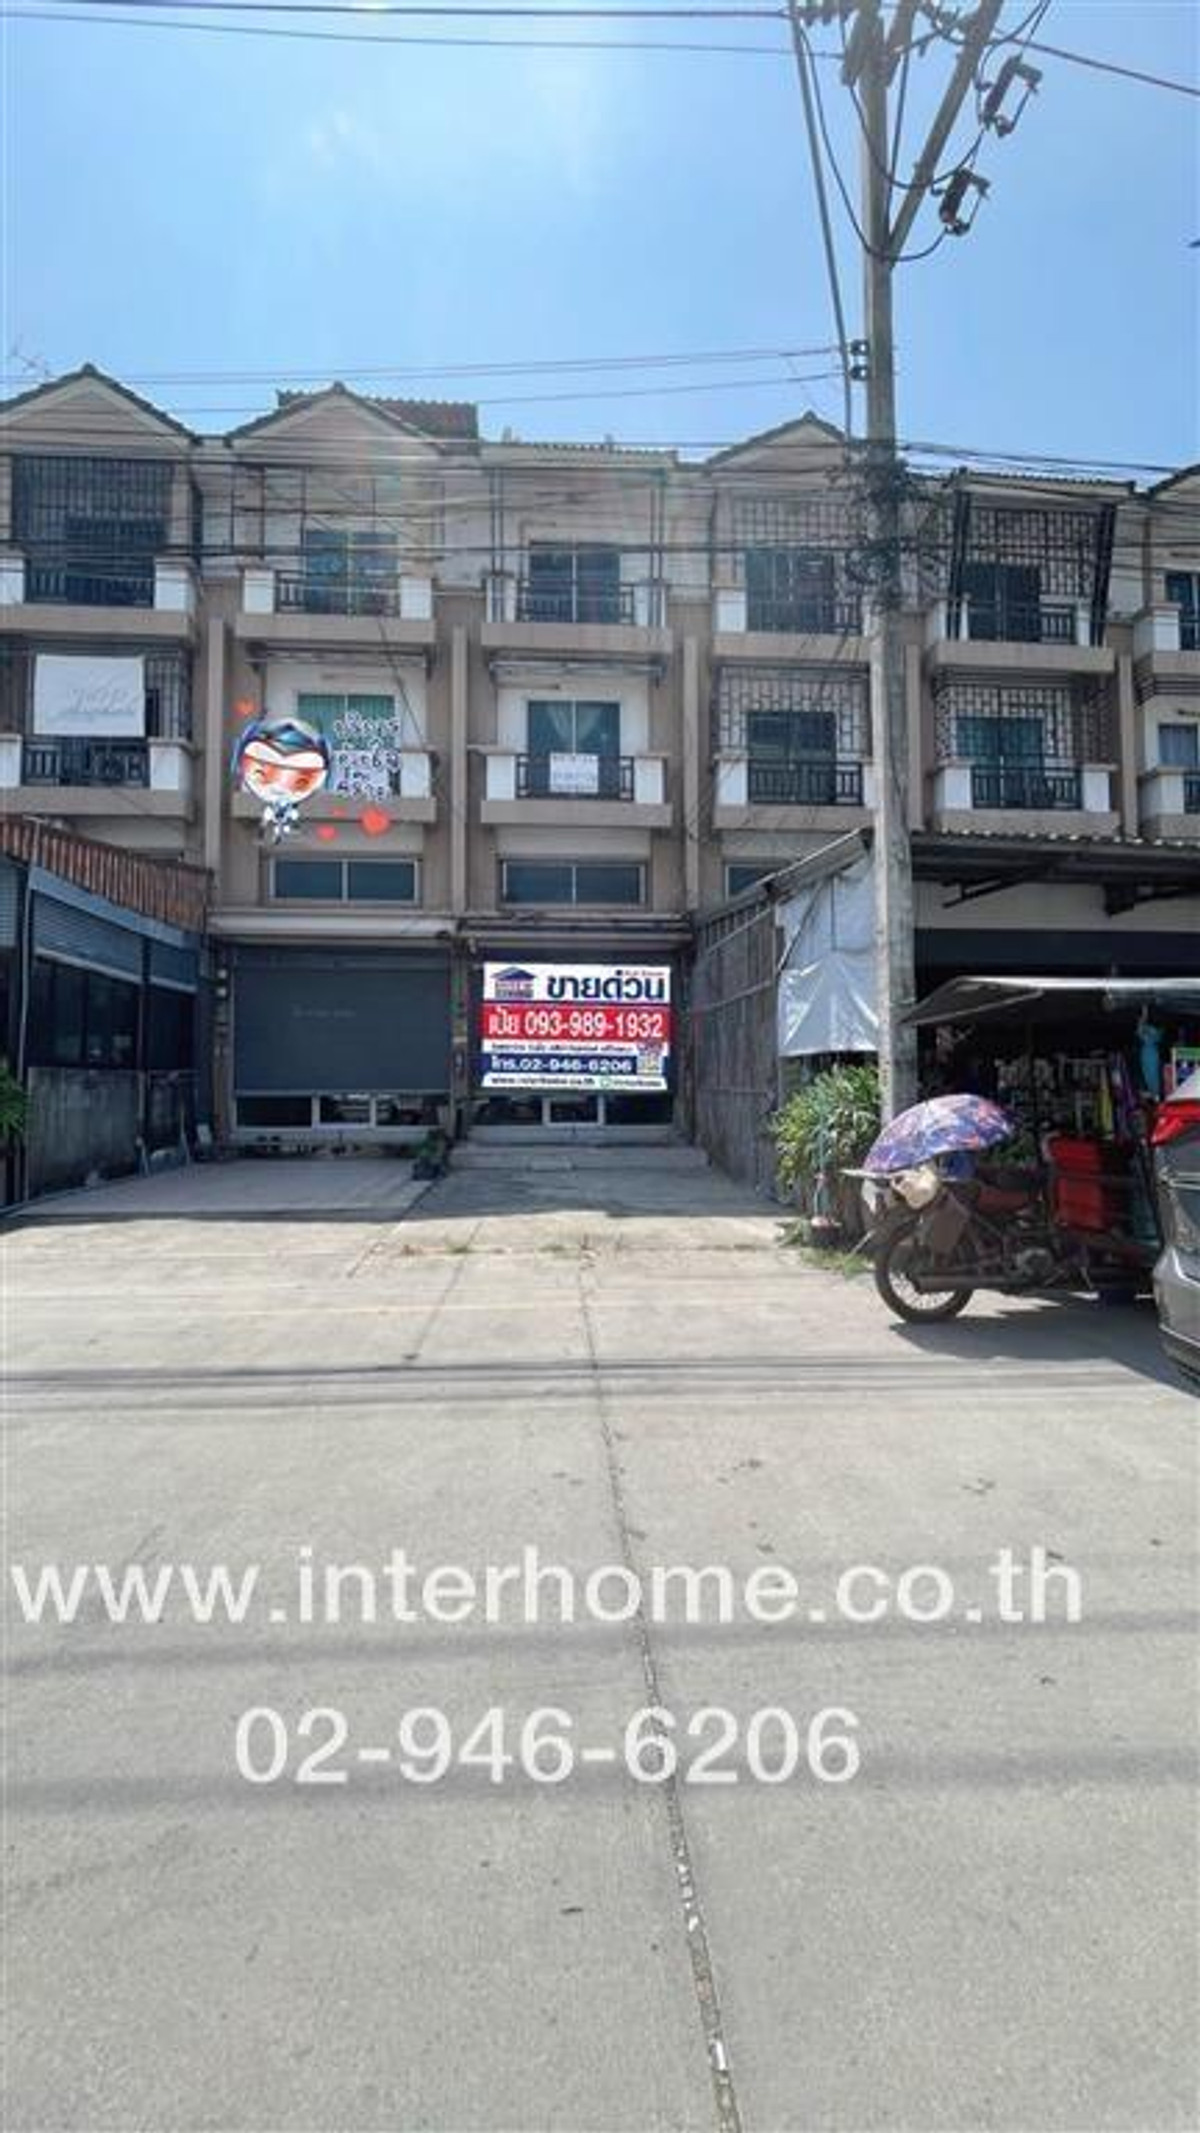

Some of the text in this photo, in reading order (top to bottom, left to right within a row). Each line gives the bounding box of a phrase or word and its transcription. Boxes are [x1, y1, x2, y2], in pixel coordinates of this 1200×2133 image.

[547, 970, 666, 999] ขายด่วน
[525, 1011, 662, 1037] 093-989-1932
